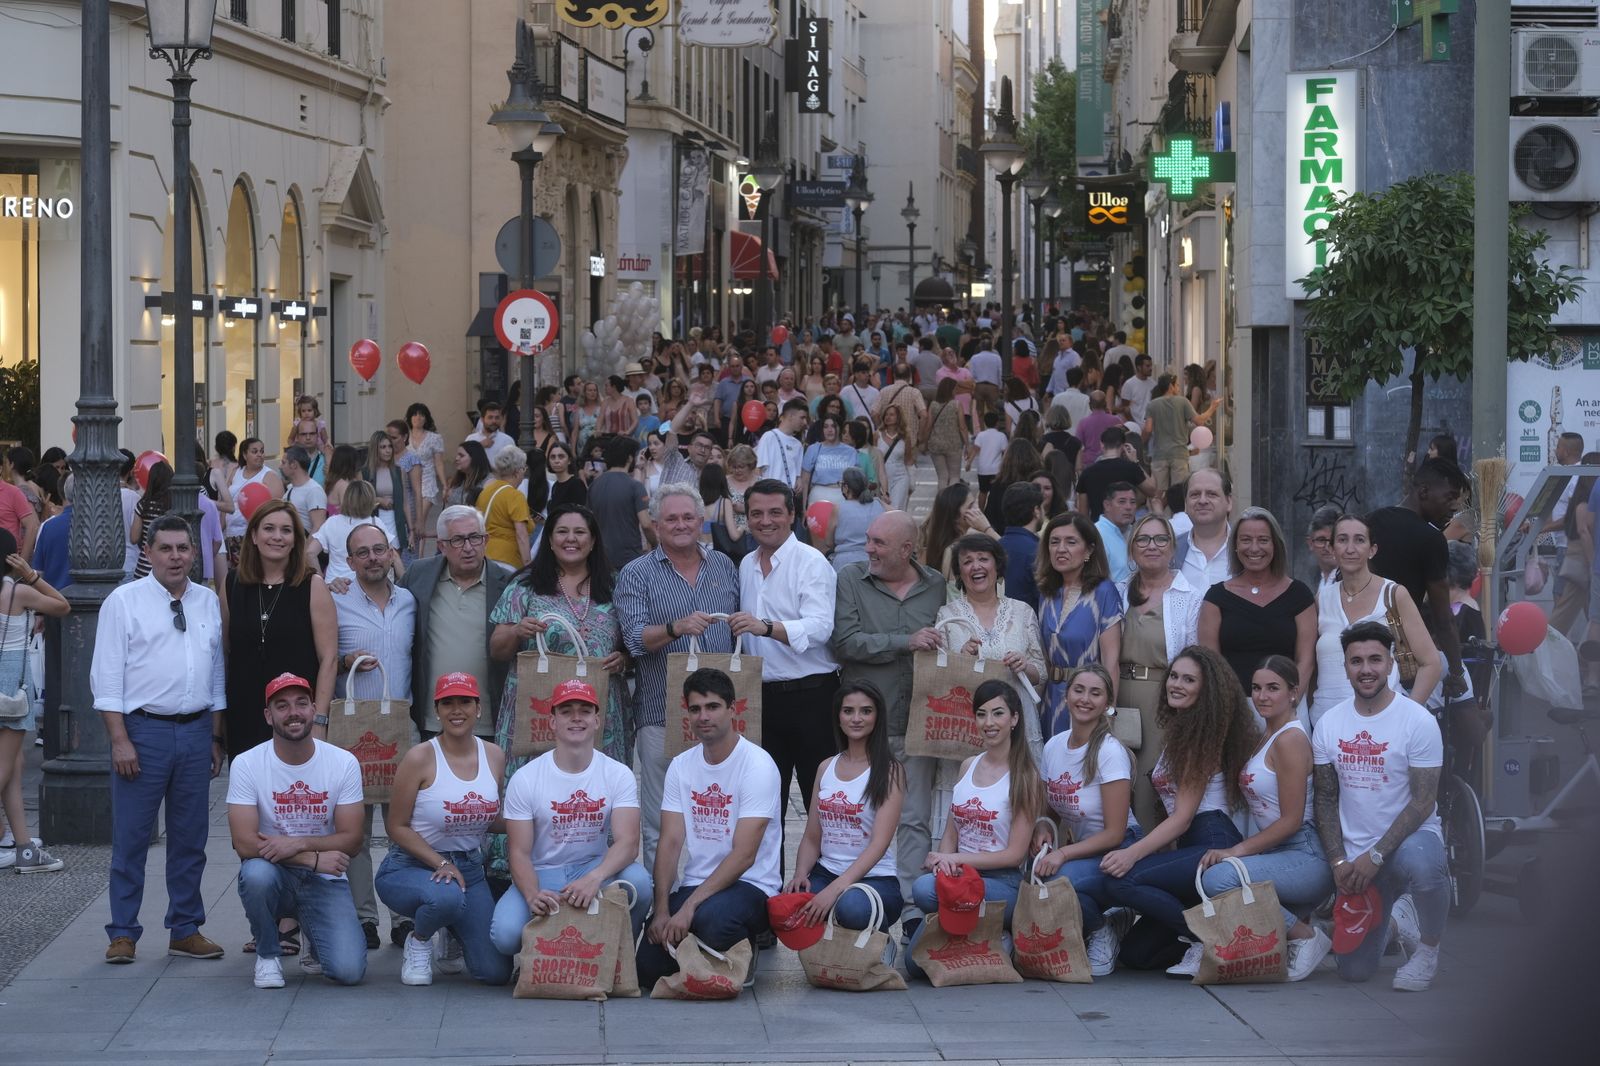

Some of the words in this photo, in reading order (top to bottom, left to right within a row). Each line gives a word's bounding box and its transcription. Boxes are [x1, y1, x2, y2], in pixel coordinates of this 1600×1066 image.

[711, 12, 723, 25] de
[1300, 78, 1343, 276] FARMACI
[1088, 192, 1129, 207] Ulloa
[679, 206, 690, 249] MATILDE
[1337, 753, 1385, 766] SHOPPING
[274, 804, 328, 815] SHOPPING
[552, 812, 604, 824] SHOPPING
[532, 958, 599, 978] SHOPPING
[1217, 952, 1281, 976] SHOPPING
[531, 971, 576, 985] NIGHT
